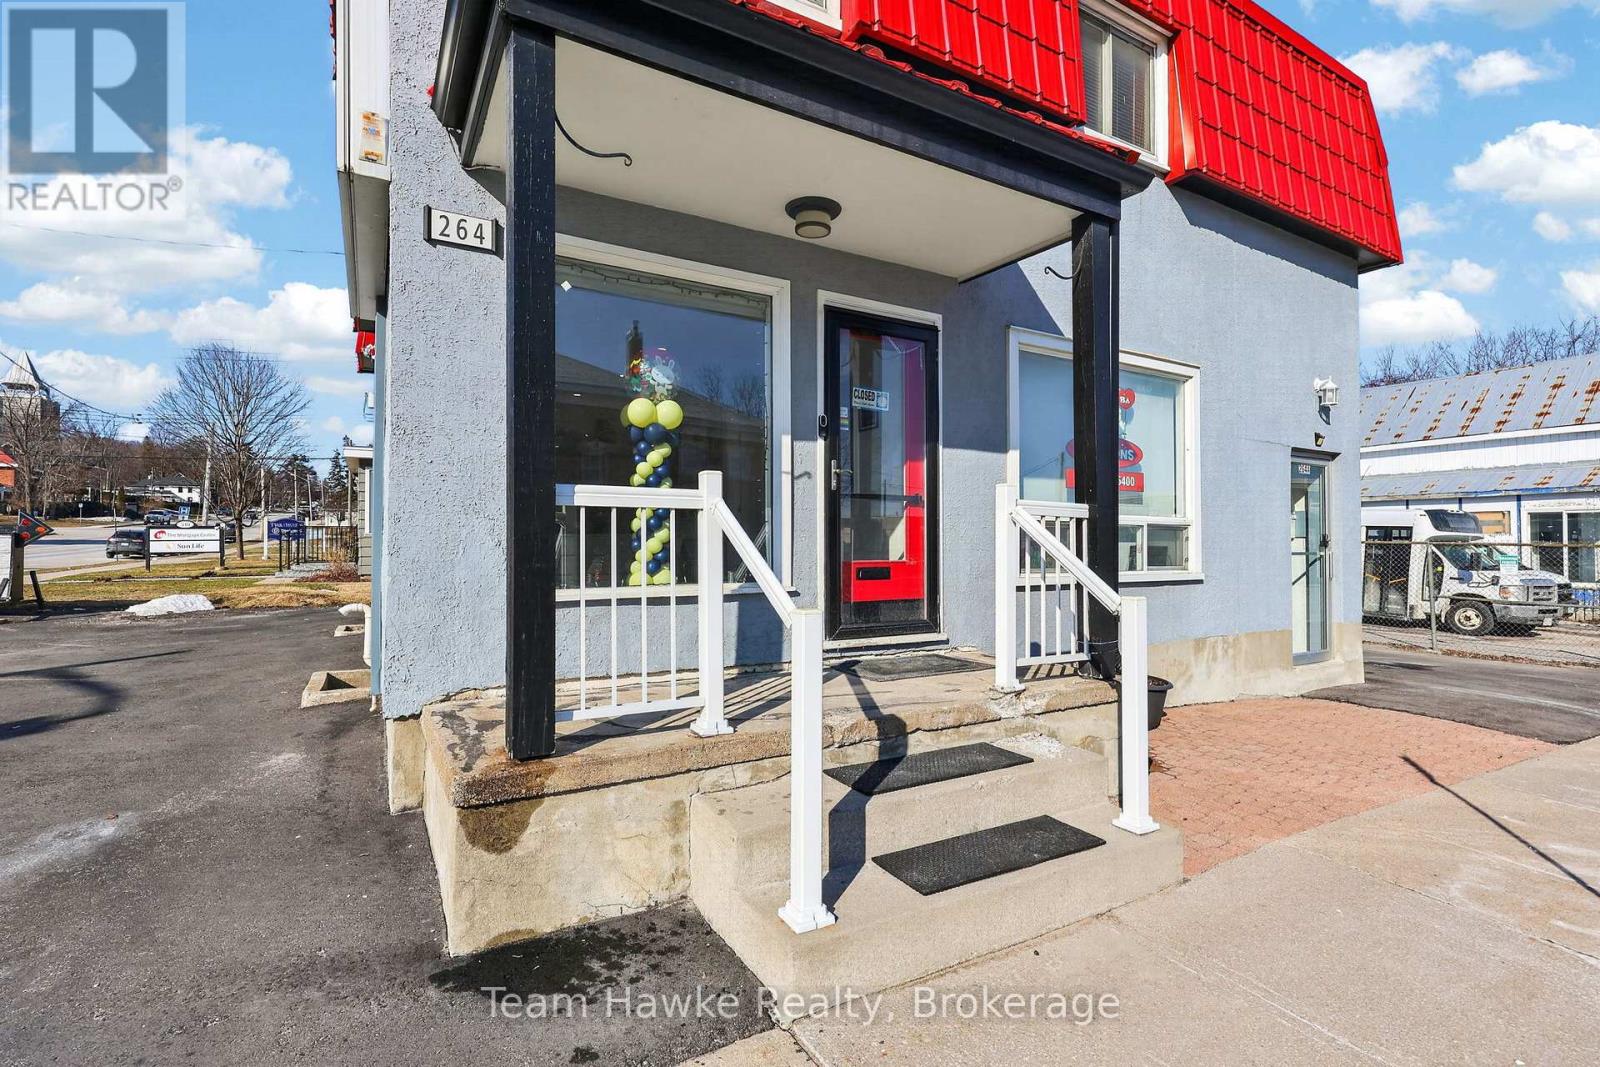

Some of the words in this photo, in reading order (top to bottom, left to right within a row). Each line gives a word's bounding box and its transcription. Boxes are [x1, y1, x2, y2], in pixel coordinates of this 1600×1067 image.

[438, 214, 486, 246] 264
[853, 389, 875, 401] CLOSED
[1119, 449, 1134, 460] NS
